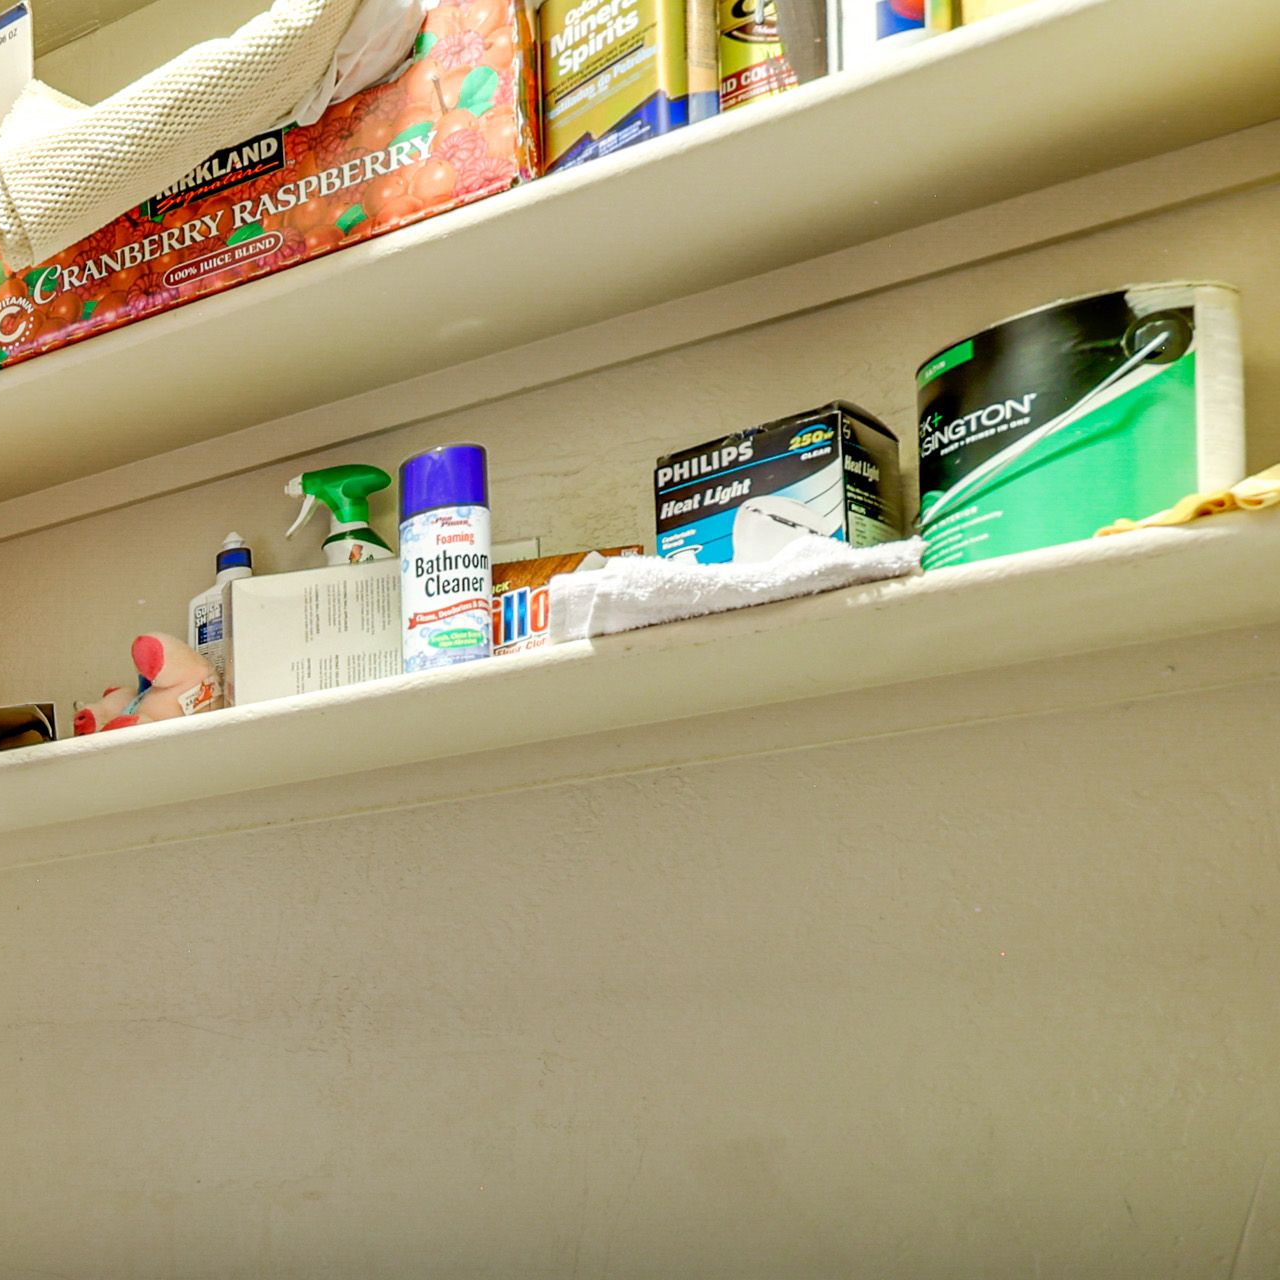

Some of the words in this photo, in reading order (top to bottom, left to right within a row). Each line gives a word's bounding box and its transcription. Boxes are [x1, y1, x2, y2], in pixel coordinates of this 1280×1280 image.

[550, 0, 639, 58] Minera
[558, 10, 639, 76] Spirits
[155, 136, 279, 200] KIRKLAND
[156, 161, 280, 215] Signature
[33, 209, 225, 306] CRANBERRY
[232, 129, 438, 230] RASPBERRY
[169, 265, 198, 283] 100%
[199, 252, 232, 273] JUICE
[234, 236, 276, 260] BLEND
[921, 394, 1031, 458] SINGTON
[657, 440, 754, 488] PHILIPS
[800, 446, 832, 461] CLEAR
[844, 454, 862, 475] Heat
[660, 496, 700, 520] Heat
[703, 478, 752, 506] Light
[436, 531, 475, 546] Foaming
[415, 549, 489, 578] Bathroom
[424, 574, 484, 597] Cleaner
[492, 580, 511, 594] ICK
[492, 586, 550, 647] illo
